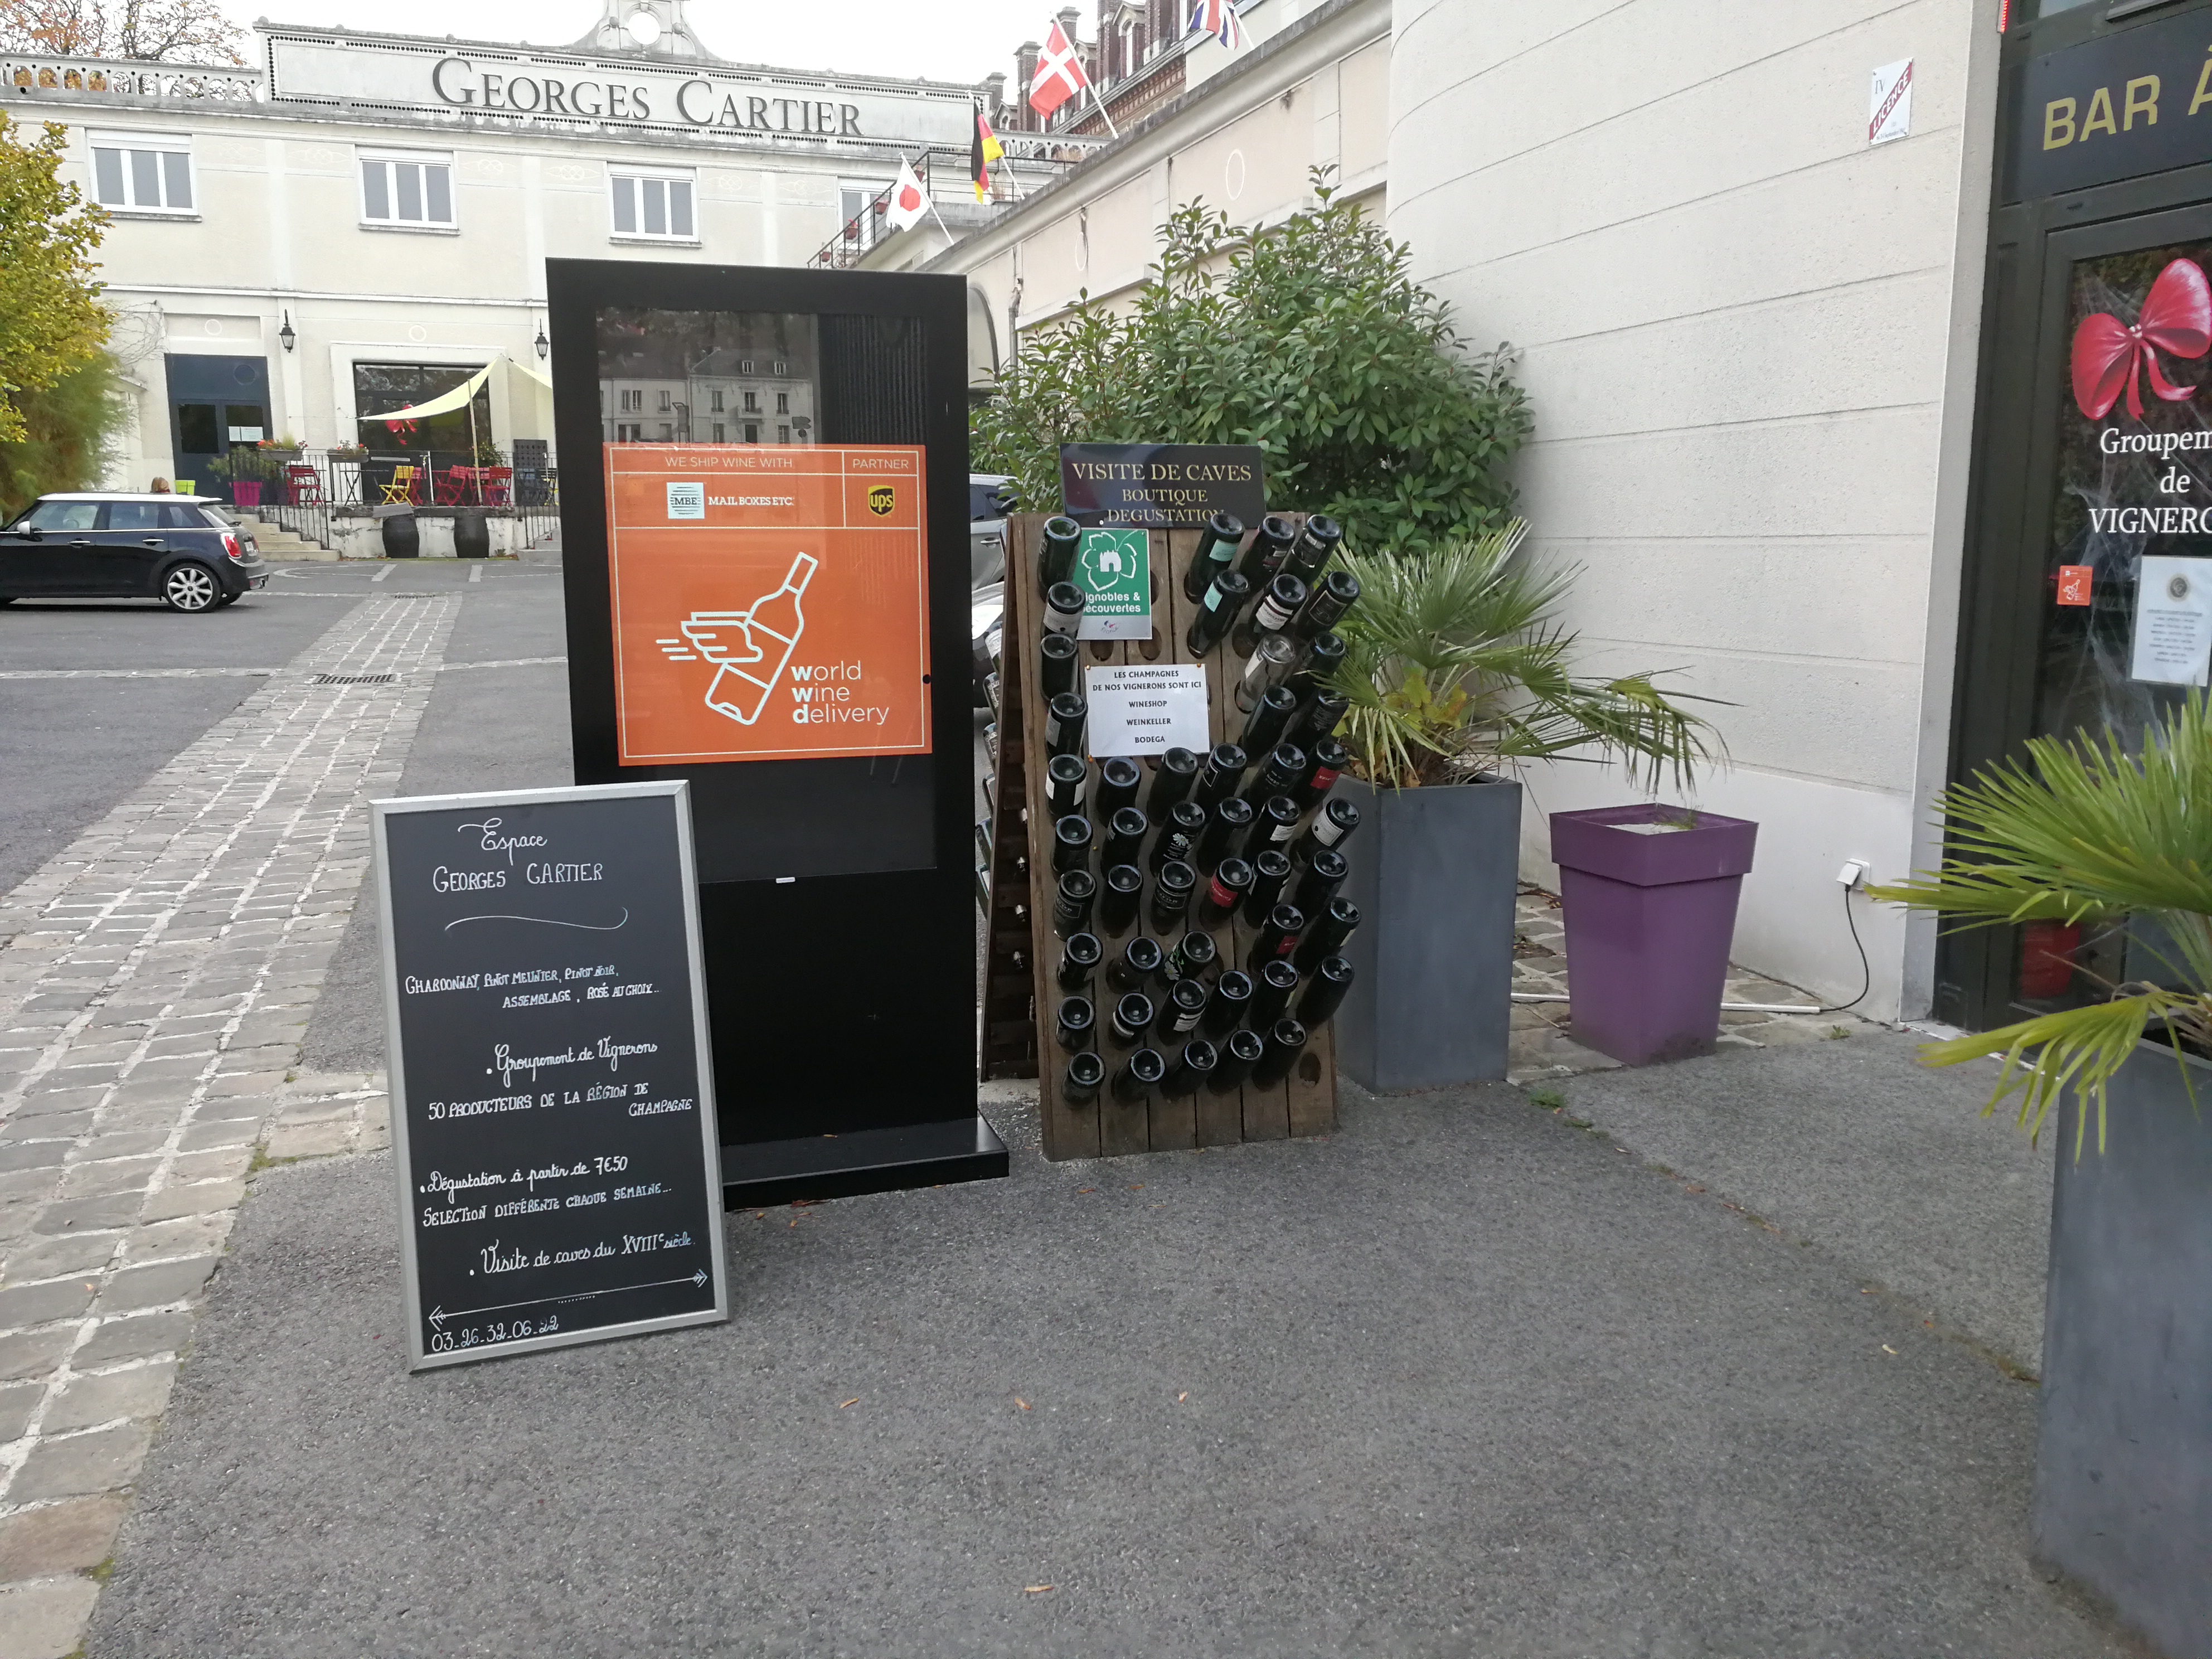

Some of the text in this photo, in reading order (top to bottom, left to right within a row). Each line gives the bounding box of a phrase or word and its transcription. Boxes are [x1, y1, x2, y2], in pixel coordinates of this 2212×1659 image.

[432, 57, 865, 137] GEORGES CARTIER
[1873, 69, 1910, 133] LICENCE
[2043, 75, 2161, 151] BAR
[665, 457, 793, 469] WE SHIP WINE WITH
[852, 458, 909, 470] PARTNER
[1072, 463, 1251, 482] VISITE DE CAVES
[2160, 467, 2191, 494] de
[674, 497, 697, 505] MBE
[708, 496, 738, 506] MAIL
[739, 496, 771, 506] BOXES
[870, 494, 893, 512] ups
[1122, 488, 1208, 506] BOUTIQUE
[1085, 591, 1141, 604] ignobles &
[1083, 603, 1141, 613] écouvertes
[791, 661, 862, 681] world
[1114, 670, 1179, 679] LES CHAMPAGNES
[792, 683, 850, 702] wine
[1104, 683, 1121, 691] NOS
[1123, 682, 1166, 691] VIGNERONS
[1168, 681, 1189, 690] SONT
[1191, 681, 1201, 689] ICI
[1128, 700, 1167, 709] WINESHOP
[792, 704, 890, 725] delivery
[1126, 717, 1171, 726] WEINKELLER
[1134, 735, 1165, 744] BODEGA
[458, 817, 548, 866] Espace
[433, 863, 603, 892] GEORGES CARTIER
[565, 967, 593, 980] PINOT
[587, 982, 610, 1000] ROSÉ
[494, 1035, 658, 1088] Groupement de Vignerons
[428, 1081, 649, 1120] 50 PRODUCTEURS DE LA RÉGION DE
[629, 1098, 692, 1117] CHAMPAGNE
[510, 1168, 524, 1183] à
[527, 1163, 570, 1192] partir
[570, 1161, 591, 1176] de
[594, 1156, 628, 1176] 7€50
[423, 1205, 488, 1227] SELECTION
[494, 1197, 560, 1217] DIFFÉRENTE
[566, 1191, 607, 1208] CHAQUE
[481, 1238, 530, 1273] Visite
[533, 1249, 551, 1267] de
[553, 1247, 591, 1264] caves
[592, 1241, 617, 1258] du
